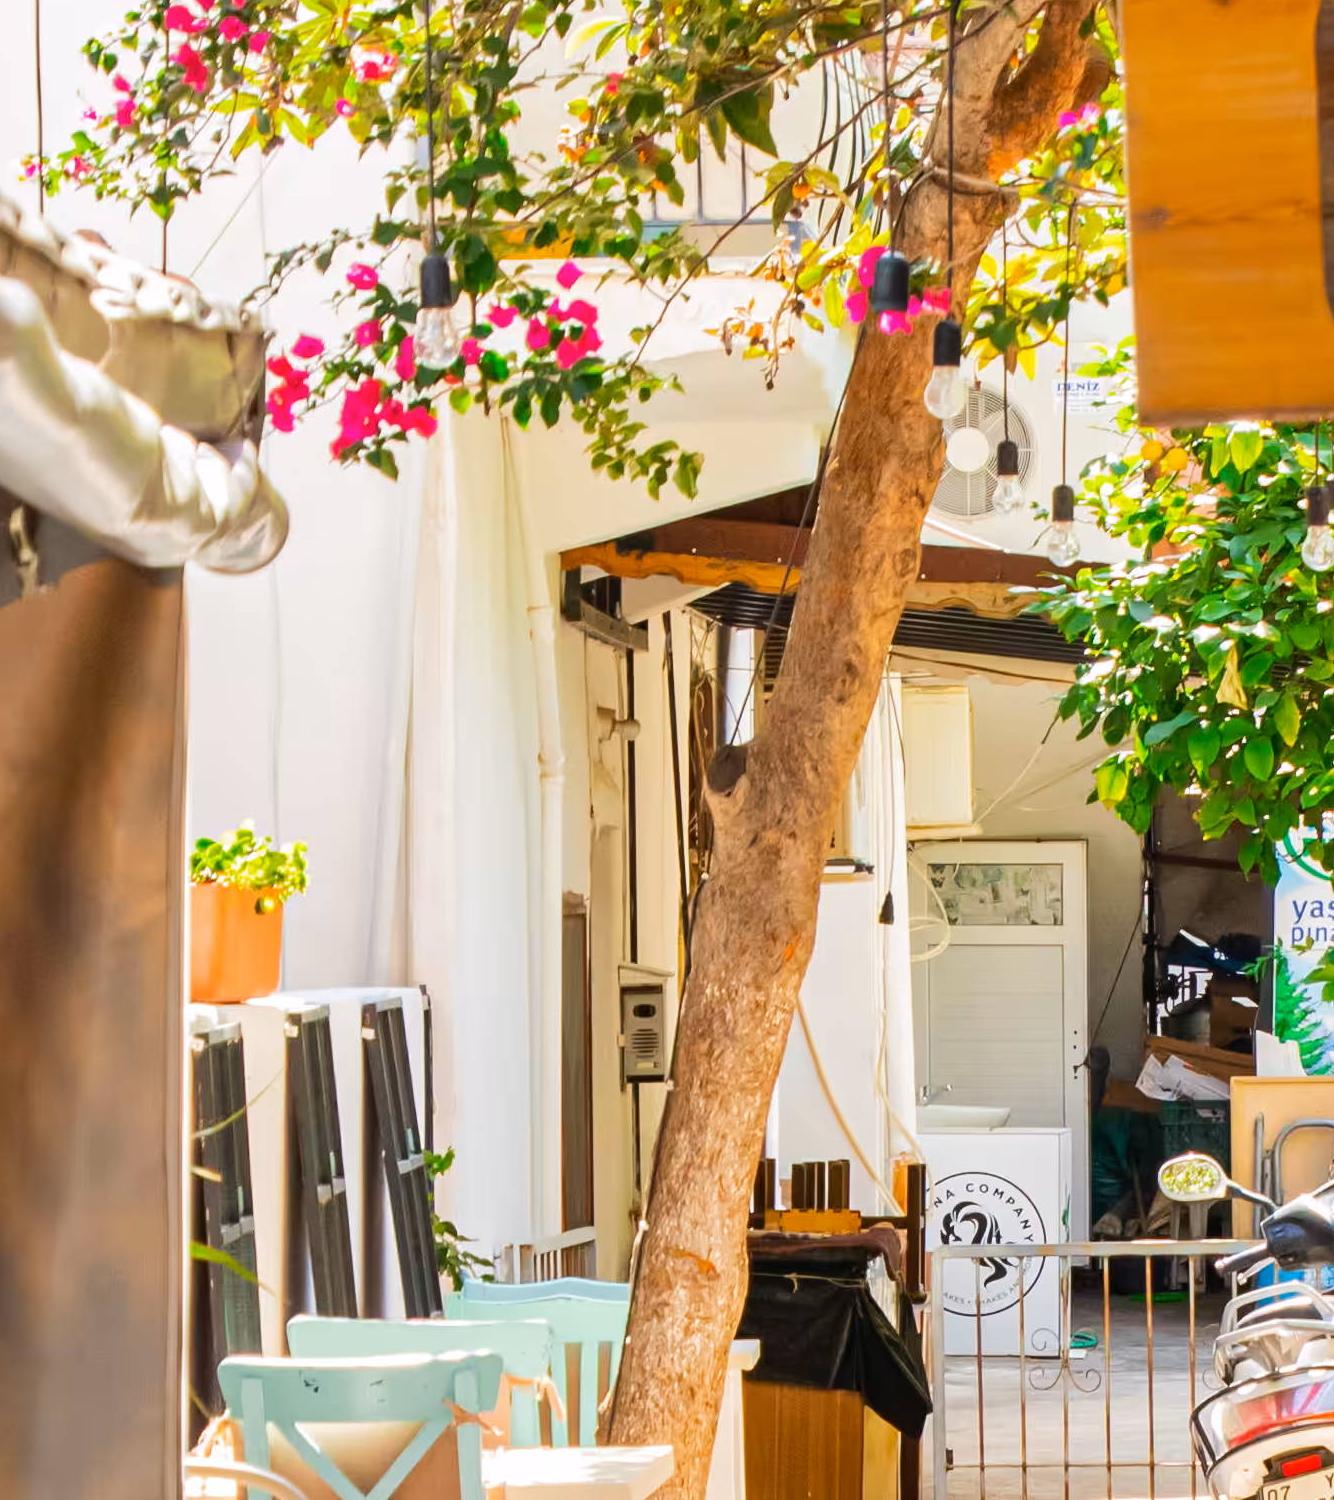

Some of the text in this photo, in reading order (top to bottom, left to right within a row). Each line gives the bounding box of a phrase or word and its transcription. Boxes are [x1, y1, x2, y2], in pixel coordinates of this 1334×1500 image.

[965, 1183, 1035, 1242] COMPANY
[943, 1292, 965, 1304] AKES
[1325, 1472, 1334, 1489] Y
